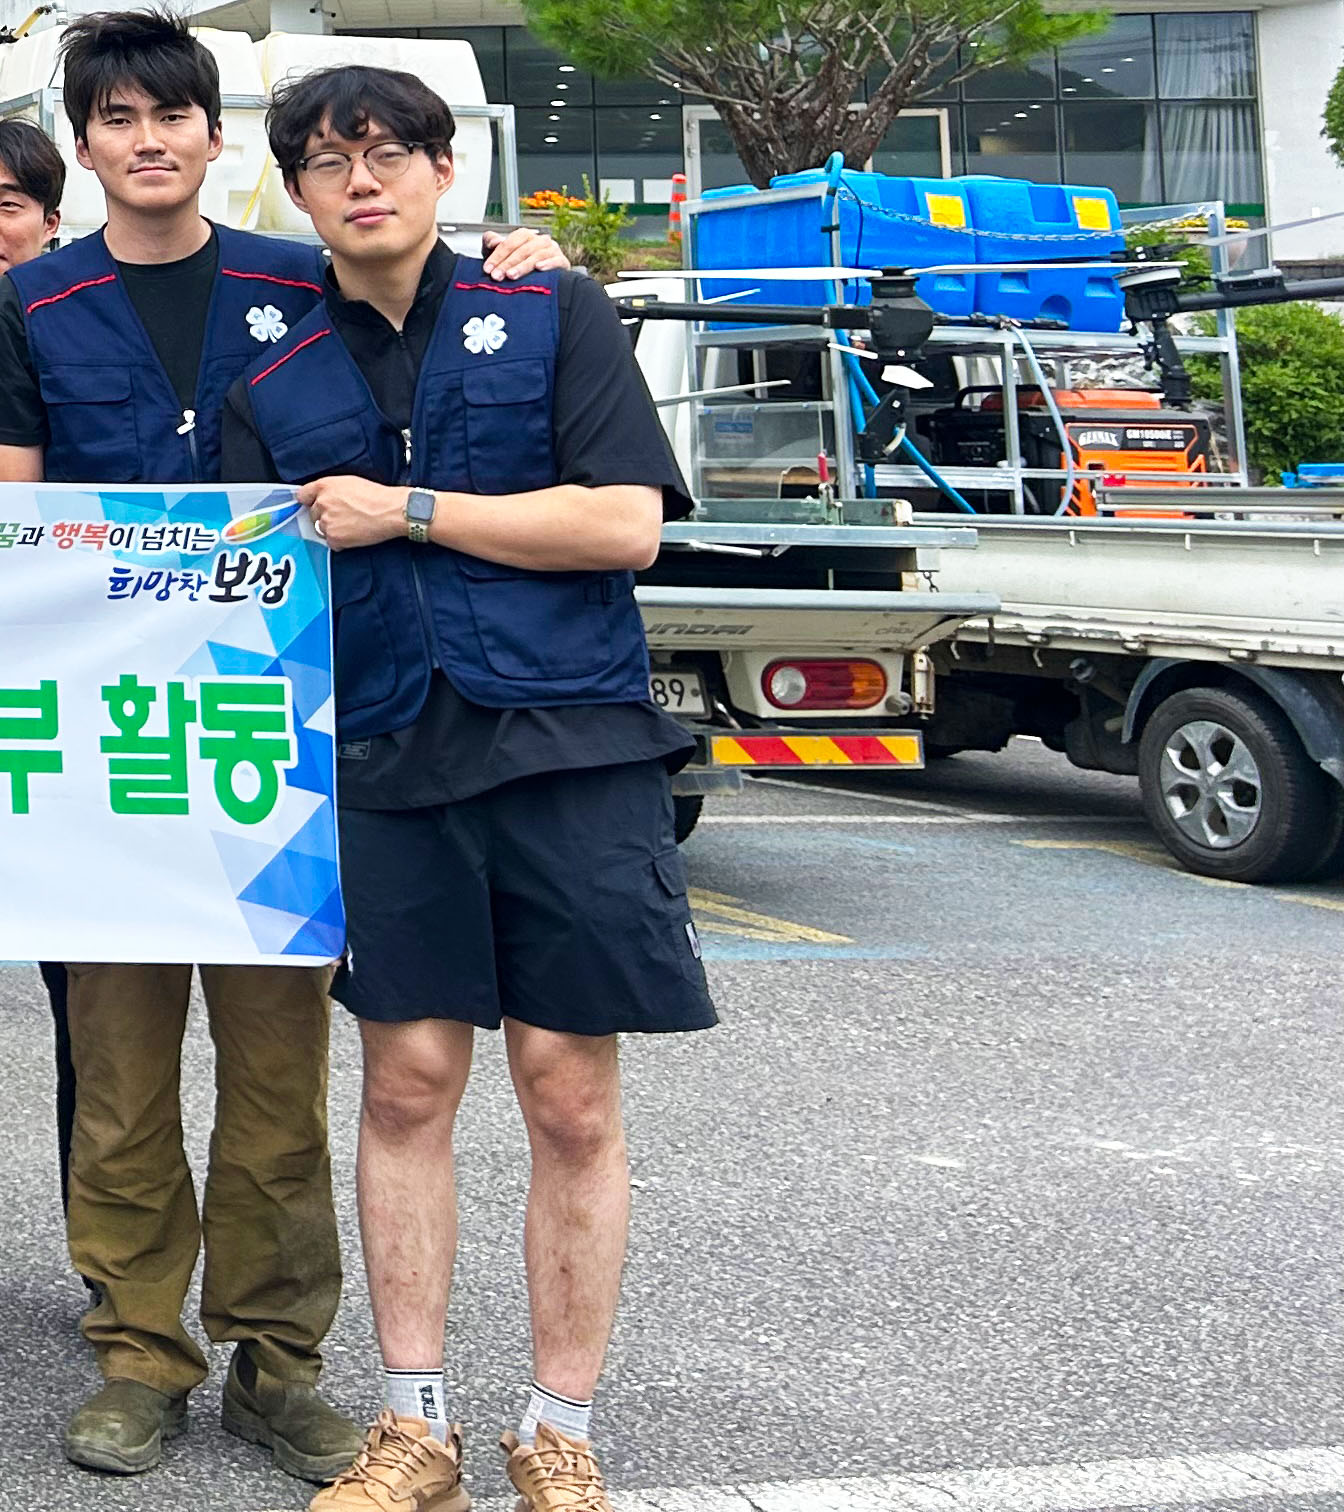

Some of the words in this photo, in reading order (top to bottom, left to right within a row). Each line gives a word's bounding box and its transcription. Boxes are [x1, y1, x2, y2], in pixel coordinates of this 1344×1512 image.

[51, 522, 135, 551] 행복이
[140, 525, 217, 552] 넘치는
[106, 566, 209, 602] 희망찬
[208, 552, 292, 604] 보성
[644, 623, 754, 635] UNDAI
[650, 678, 686, 708] 89
[99, 674, 292, 826] 활동
